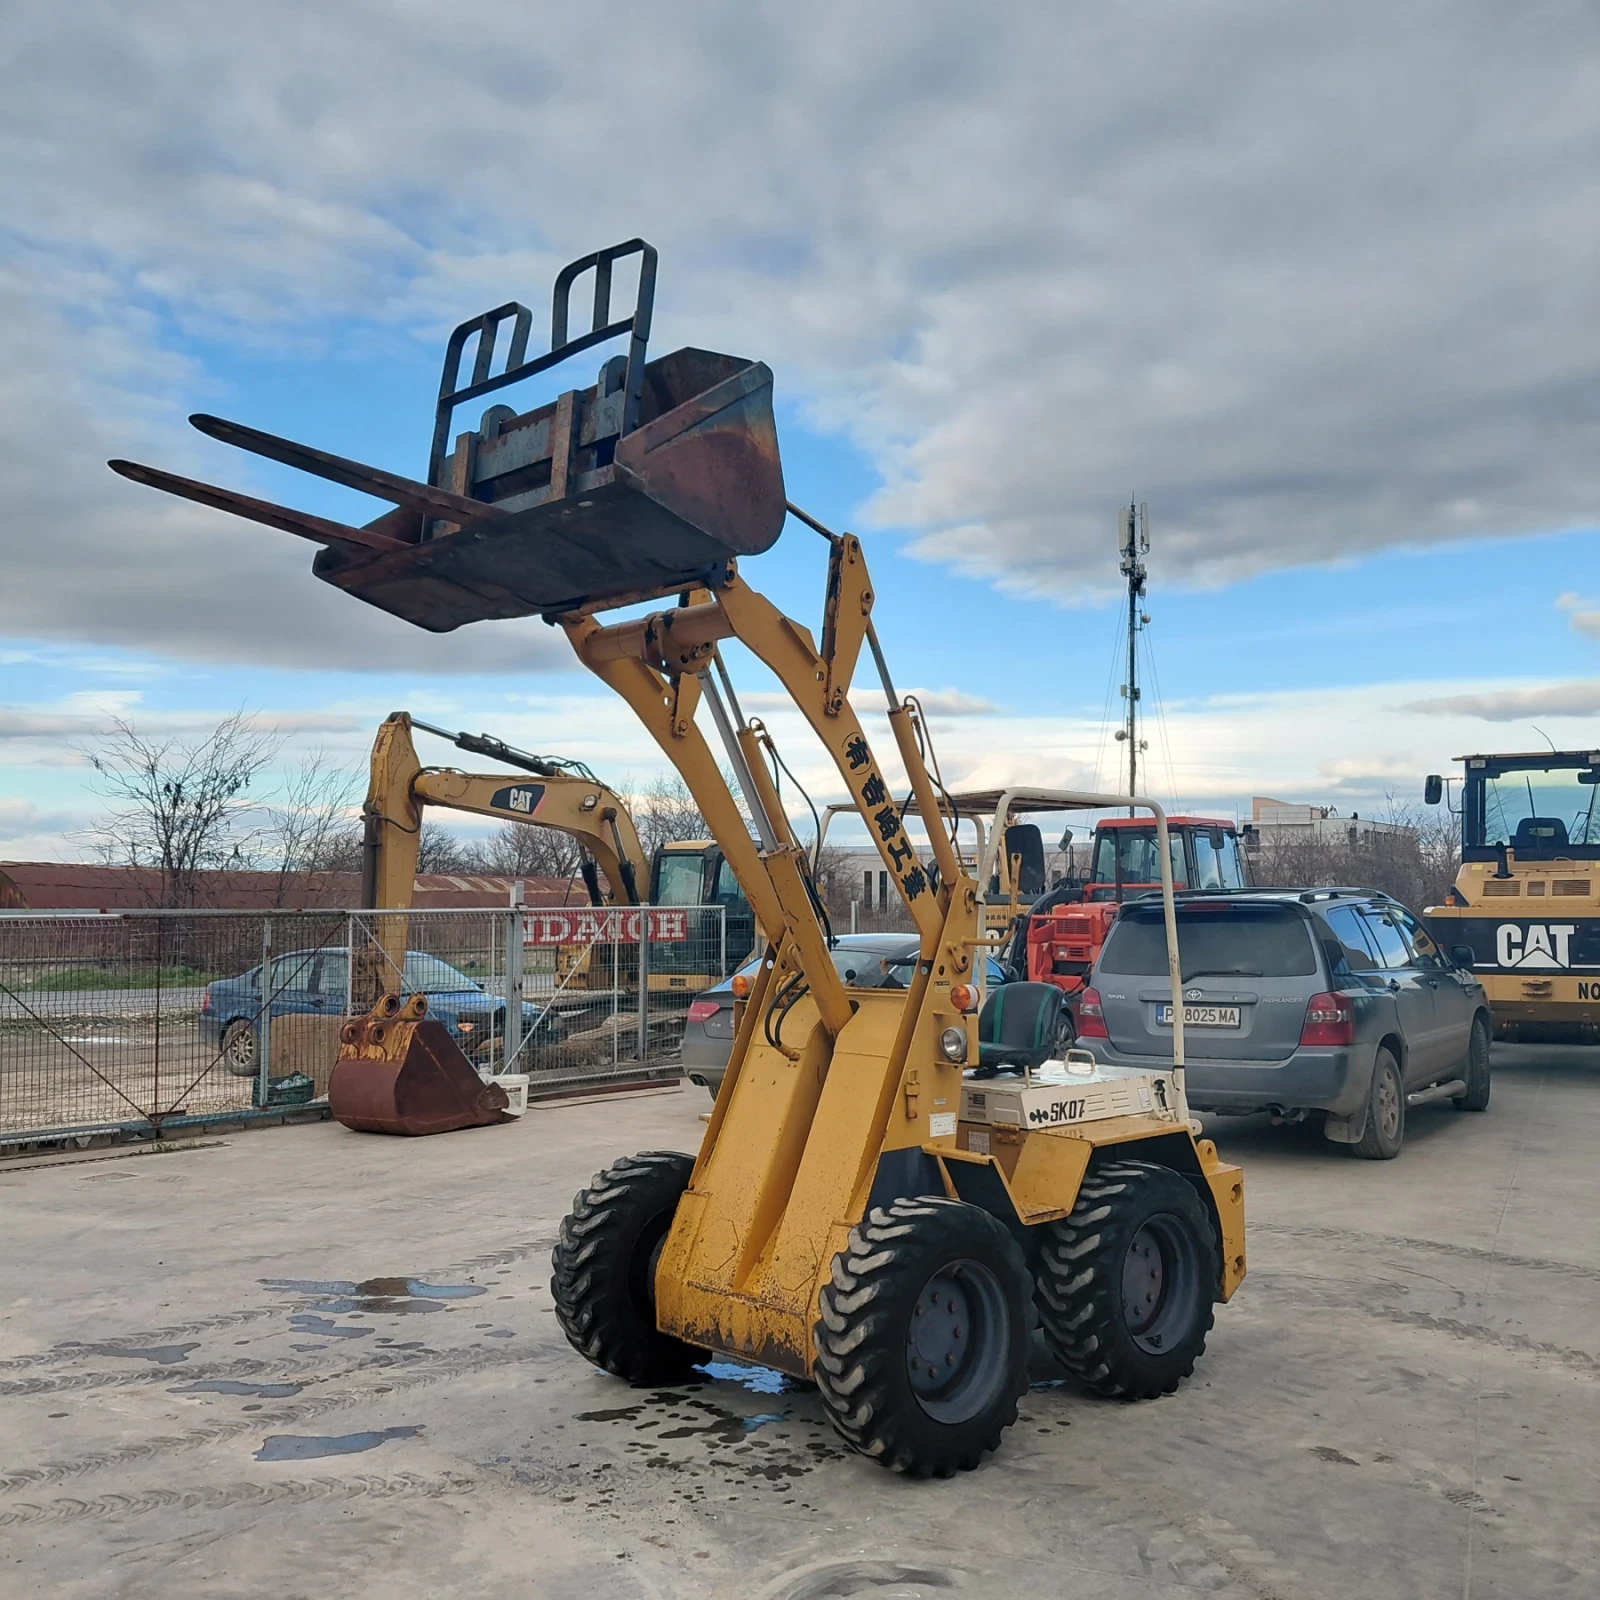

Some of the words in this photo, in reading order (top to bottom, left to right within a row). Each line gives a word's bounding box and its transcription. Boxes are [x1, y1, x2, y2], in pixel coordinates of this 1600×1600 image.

[509, 787, 533, 813] CAT
[1496, 923, 1575, 968] CAT
[1218, 1009, 1236, 1023] MA
[1050, 1099, 1085, 1122] SK07
